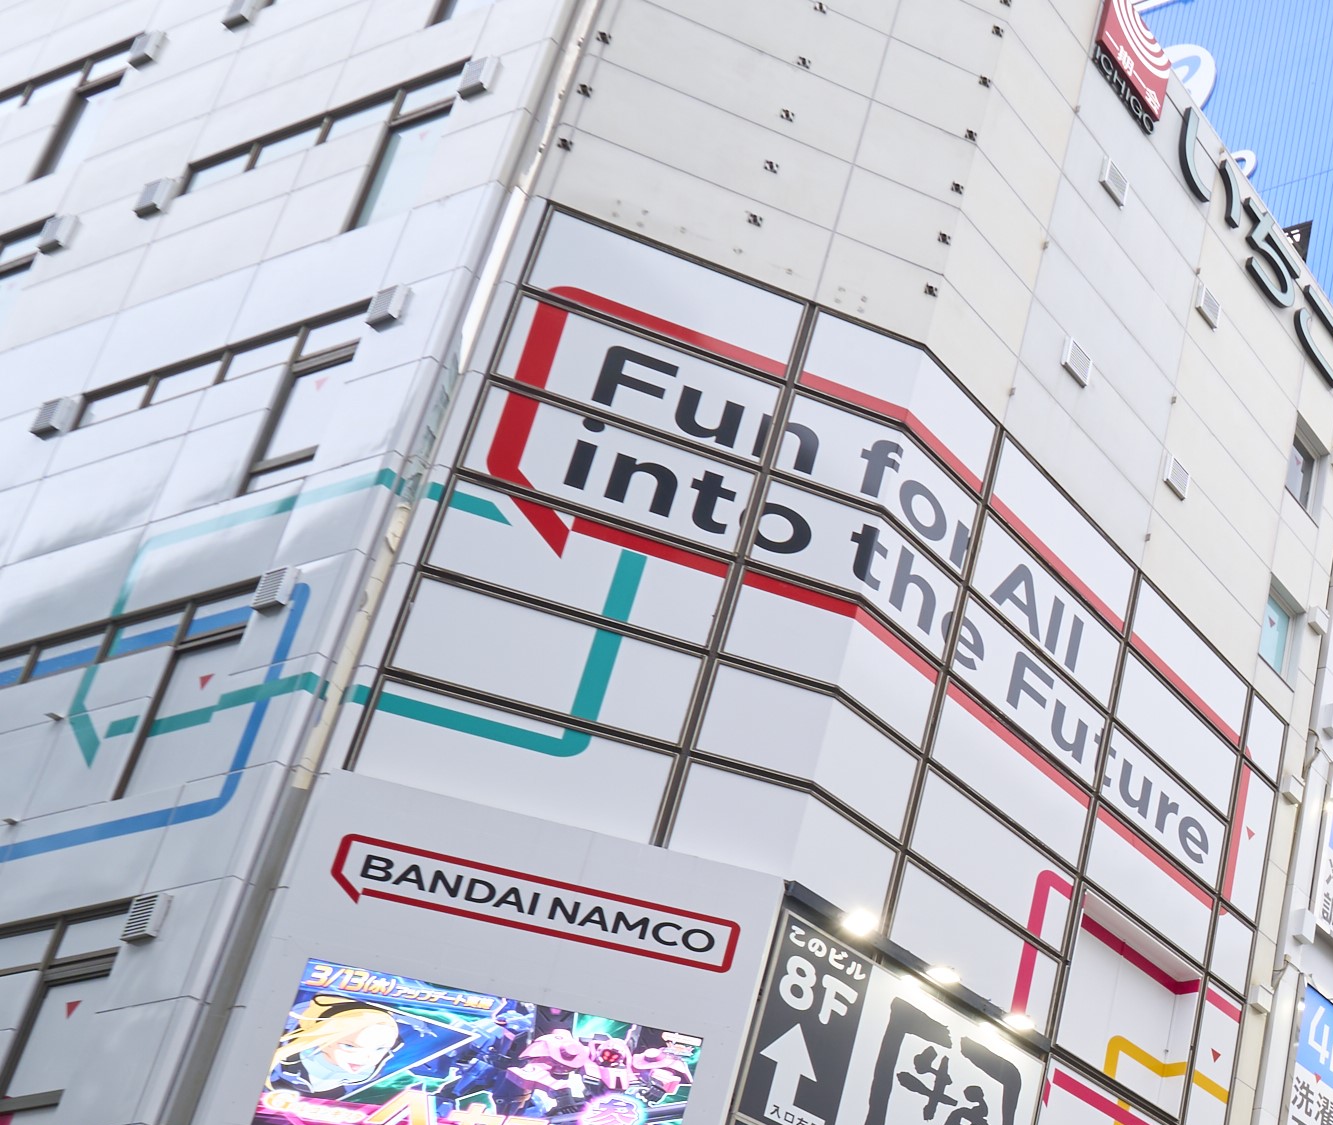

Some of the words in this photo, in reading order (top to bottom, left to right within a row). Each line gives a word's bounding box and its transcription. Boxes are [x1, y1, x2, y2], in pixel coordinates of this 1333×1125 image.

[591, 345, 820, 475] Fun
[860, 439, 972, 567] for
[990, 563, 1085, 670] All
[562, 416, 812, 555] into
[850, 525, 985, 672] the
[1005, 650, 1210, 865] Future
[360, 853, 541, 919] BANDAI
[548, 896, 716, 955] NAMCO
[788, 924, 867, 982] このビル
[778, 954, 859, 1026] 8F
